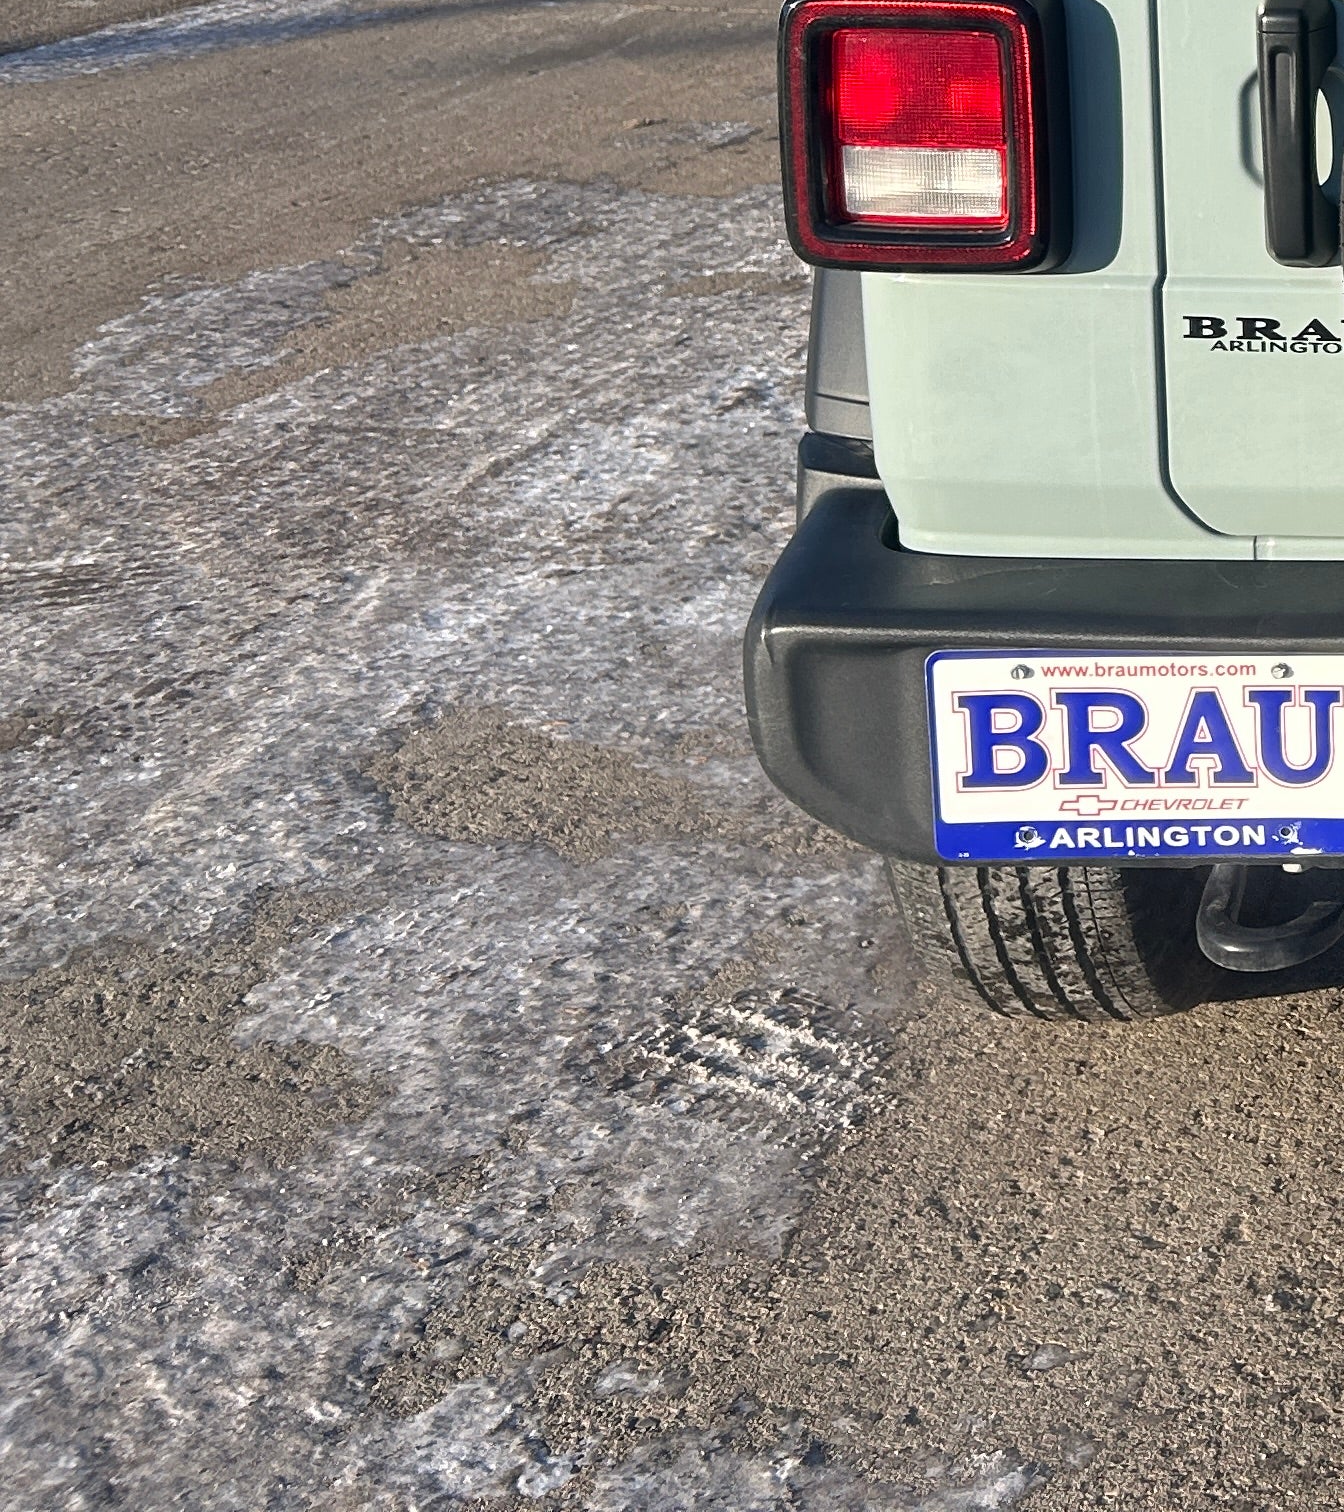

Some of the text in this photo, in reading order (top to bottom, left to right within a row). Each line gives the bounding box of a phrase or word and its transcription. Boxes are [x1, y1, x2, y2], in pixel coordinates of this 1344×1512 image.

[1041, 661, 1257, 679] www.braumotors.com
[951, 684, 1344, 794] BRAU
[1120, 797, 1249, 812] CHEVROLET
[1049, 824, 1267, 849] ARLINGTON
